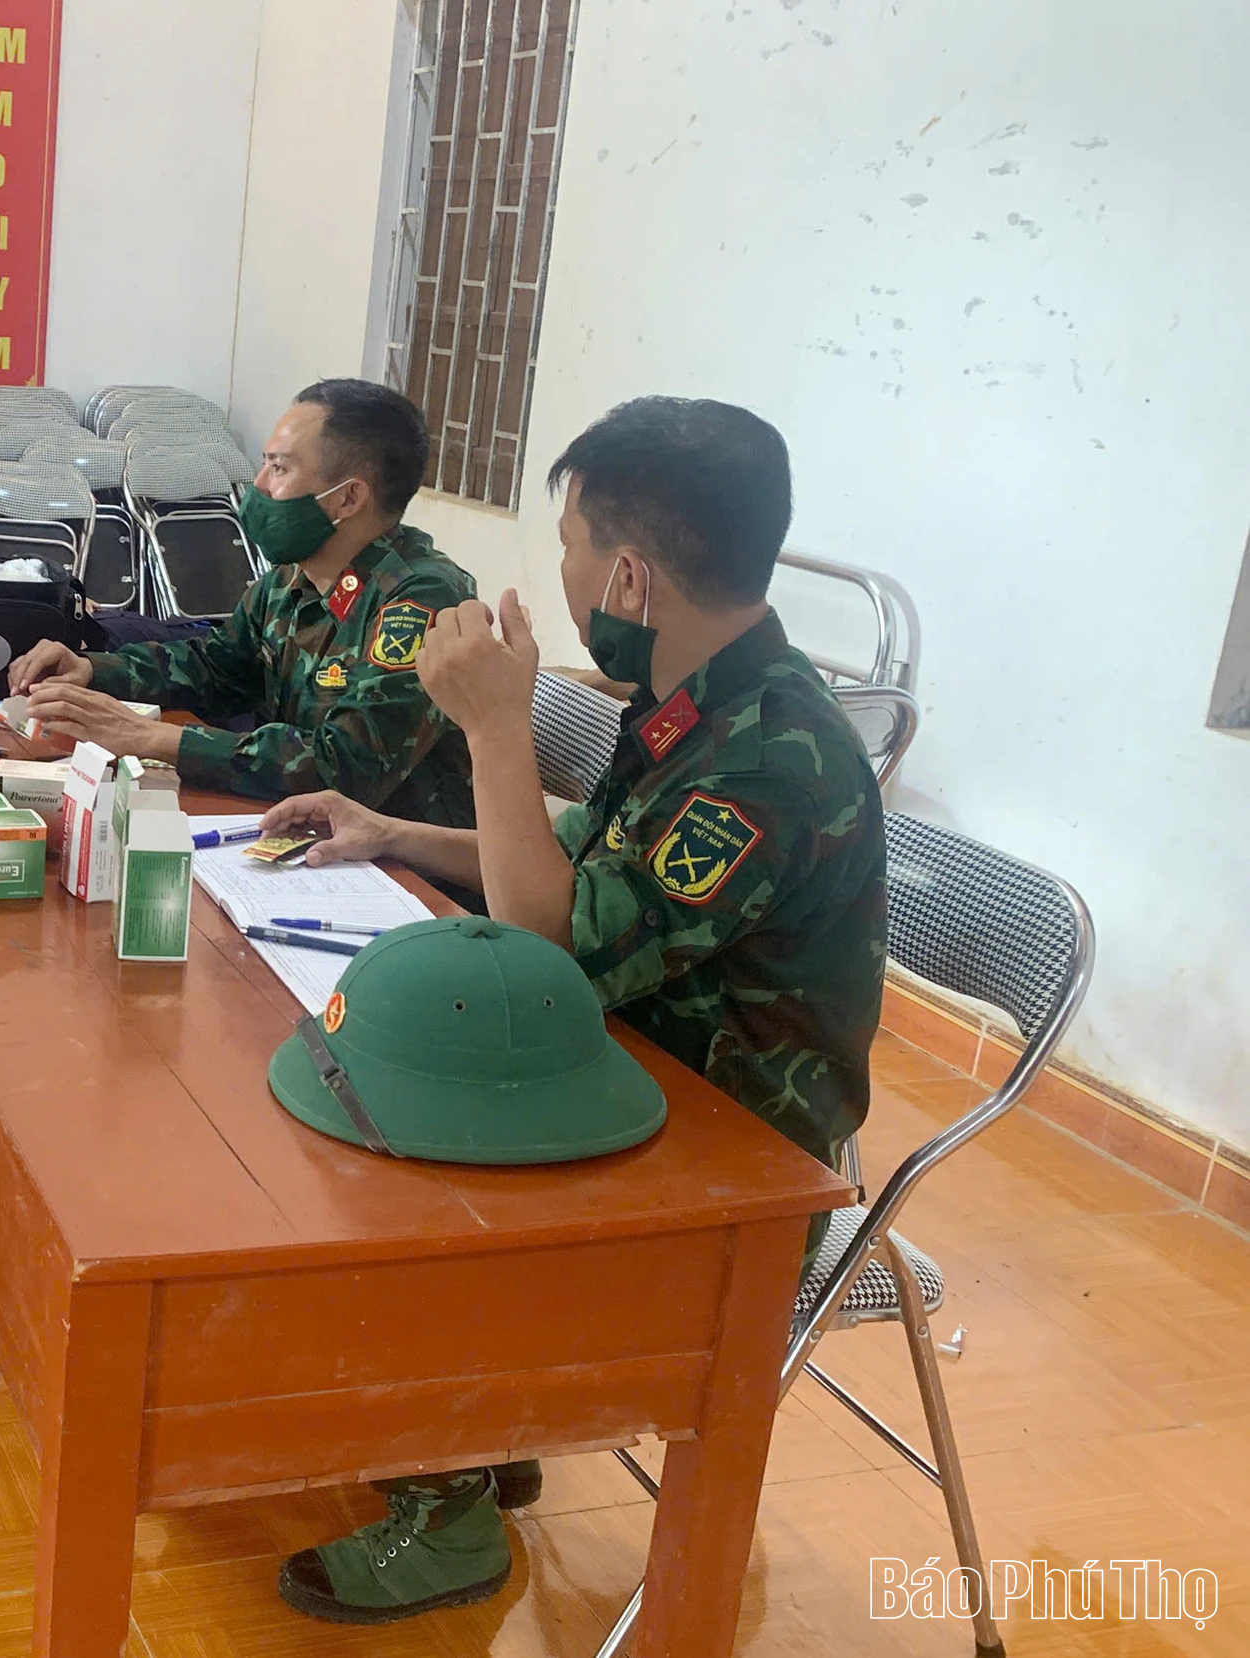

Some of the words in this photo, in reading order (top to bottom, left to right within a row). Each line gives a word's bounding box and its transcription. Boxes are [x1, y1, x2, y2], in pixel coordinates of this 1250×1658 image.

[686, 811, 704, 824] QUÂN
[713, 826, 731, 841] NHÂN
[730, 836, 744, 848] DÂN
[692, 827, 709, 839] VIỆT
[707, 836, 724, 849] NAM
